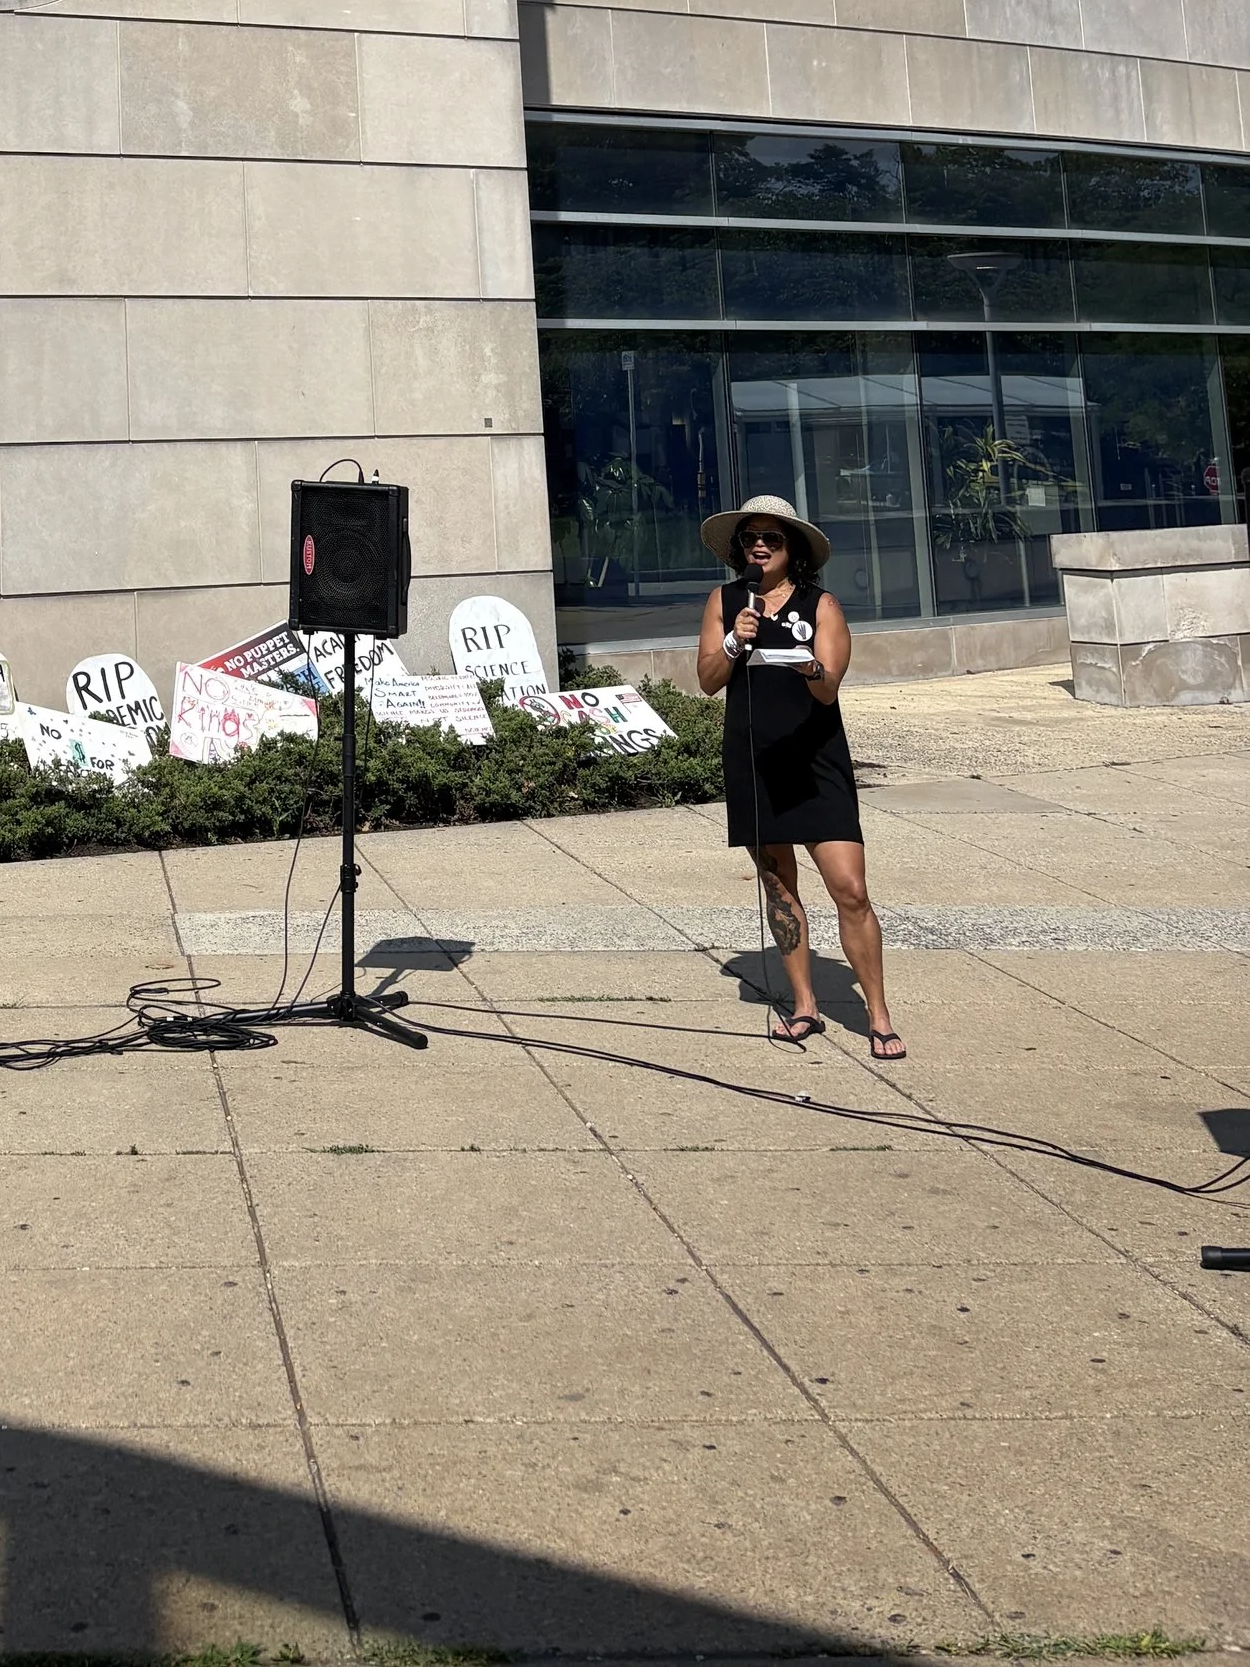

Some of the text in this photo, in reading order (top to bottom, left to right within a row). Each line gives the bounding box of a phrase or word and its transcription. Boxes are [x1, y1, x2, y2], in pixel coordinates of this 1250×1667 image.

[224, 631, 291, 672] NO PUPPET
[460, 623, 511, 653] RIP
[239, 643, 301, 679] MASTERS.
[323, 642, 394, 689] FREDOM
[464, 660, 531, 680] SCIENCE
[72, 661, 135, 711] RIP
[183, 671, 230, 701] NO
[501, 683, 547, 703] ATION
[105, 695, 165, 726] DEMIC
[558, 692, 600, 710] NO
[560, 706, 629, 725] CASH
[39, 723, 62, 740] NO
[592, 728, 664, 756] INGS
[89, 756, 115, 772] FOR
